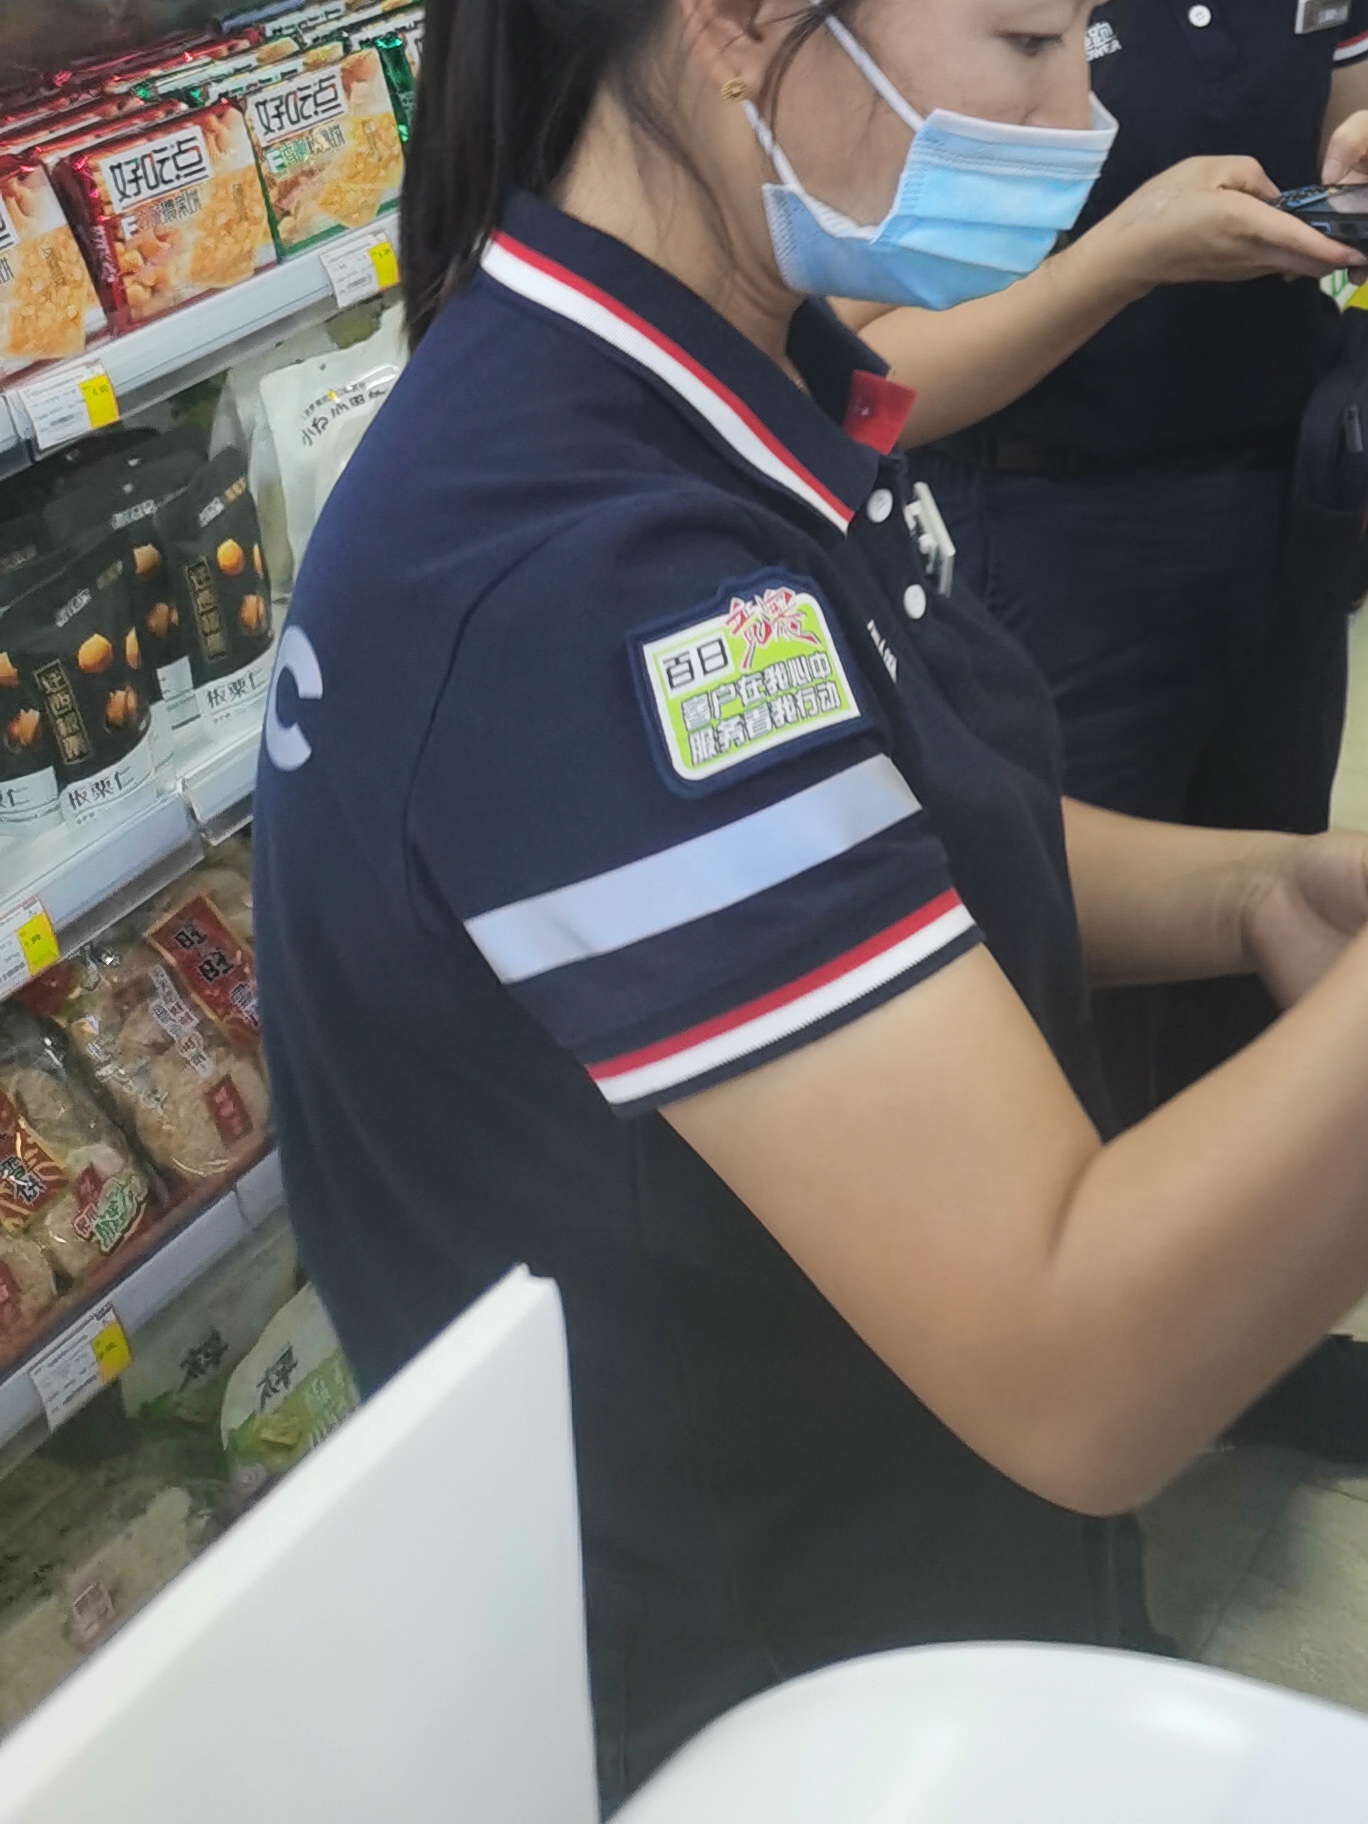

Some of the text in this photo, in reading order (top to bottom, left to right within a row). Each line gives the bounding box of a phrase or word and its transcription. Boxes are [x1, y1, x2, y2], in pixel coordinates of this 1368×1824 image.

[254, 74, 347, 135] 好吃点
[108, 134, 210, 201] 好吃点
[206, 666, 266, 710] 板栗仁
[662, 637, 729, 692] 百日
[681, 650, 833, 733] 客户在我心中
[688, 679, 842, 767] 服务看我行动
[67, 763, 134, 811] 板栗仁
